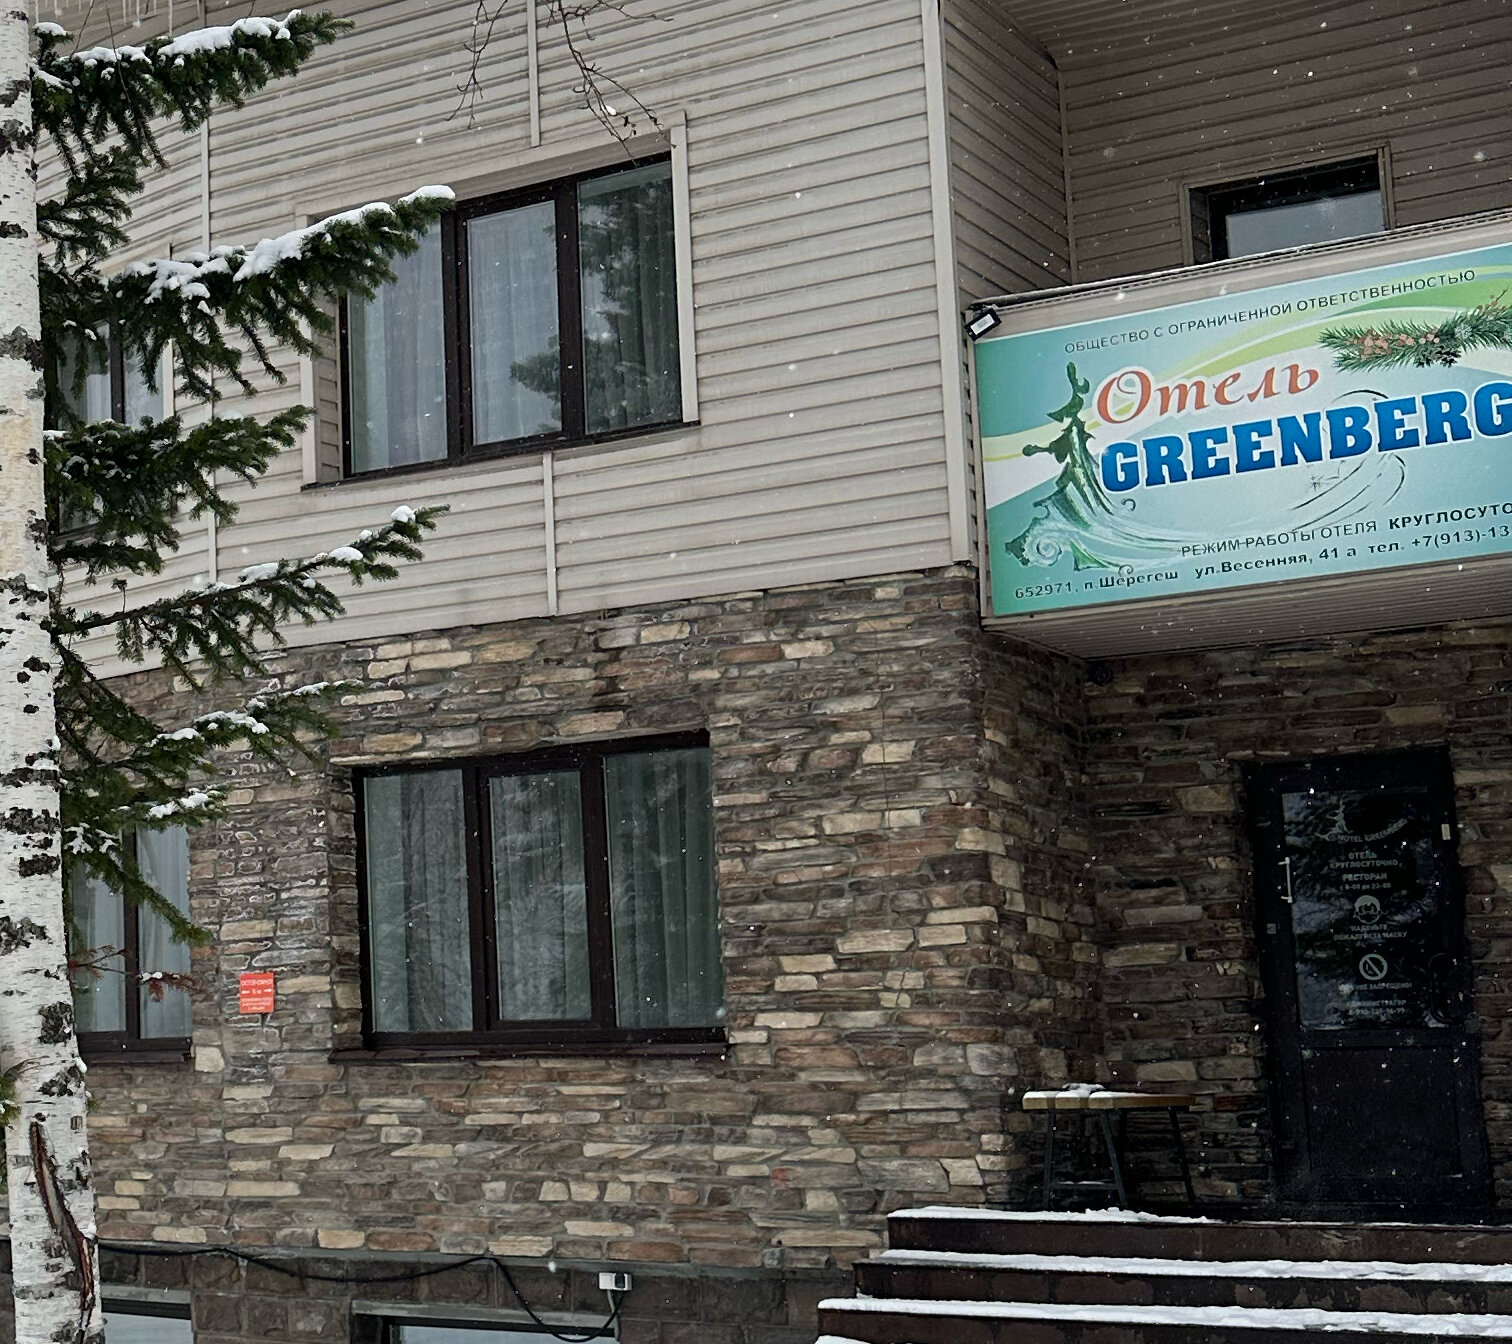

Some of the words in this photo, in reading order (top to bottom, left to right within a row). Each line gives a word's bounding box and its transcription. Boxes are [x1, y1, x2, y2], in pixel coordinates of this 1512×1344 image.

[1064, 329, 1150, 354] ОБЩЕСТВО
[1153, 326, 1164, 338] С
[1168, 301, 1292, 335] ОГРАНИЧЕННОЙ
[1296, 269, 1476, 312] ОТВЕТСТВЕННОСТЬЮ
[1097, 362, 1319, 425] Отель
[1100, 382, 1512, 493] GREENBERG
[1014, 581, 1079, 600] 652971,
[1319, 547, 1340, 560] 41
[1346, 546, 1357, 558] а
[1368, 542, 1405, 555] тел.
[1411, 525, 1512, 549] +7(913)-13
[1181, 537, 1241, 558] РЕЖИМ
[1245, 528, 1316, 550] РАБОТЫ
[1320, 520, 1378, 539] ОТЕЛЯ
[1342, 873, 1387, 881] РЕСТОРАН
[1348, 851, 1377, 859] ОТЕЛЬ
